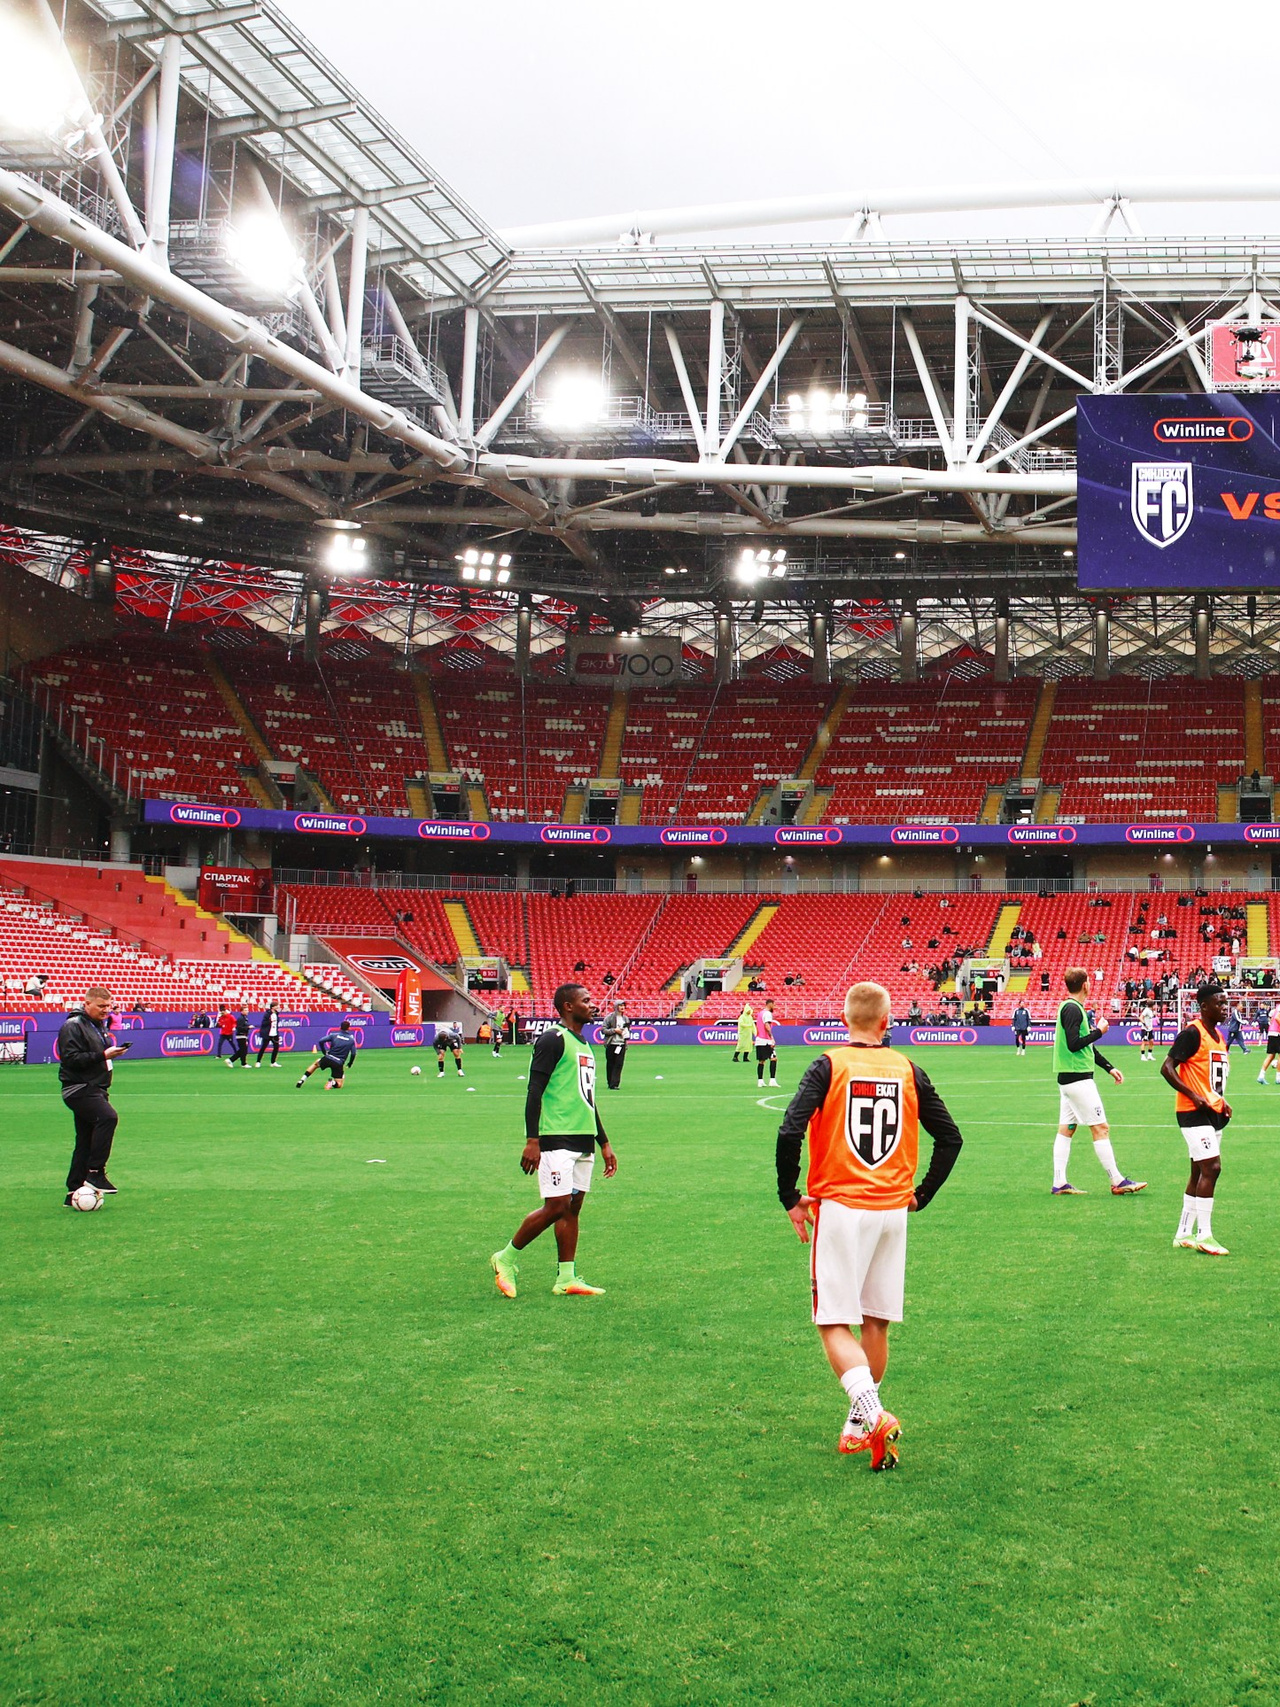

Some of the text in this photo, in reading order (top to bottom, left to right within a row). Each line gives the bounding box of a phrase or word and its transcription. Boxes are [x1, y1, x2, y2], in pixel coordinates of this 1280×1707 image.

[1162, 423, 1226, 438] Winline
[1138, 481, 1187, 540] FC
[178, 808, 221, 822] Winline
[302, 817, 347, 831] Winline
[425, 825, 471, 837] Winline
[547, 829, 592, 840] Winline
[667, 831, 709, 842] Winline
[781, 831, 824, 841] Winline
[897, 830, 940, 840] Winline
[1014, 829, 1057, 840] Winline
[1132, 829, 1175, 839] Winline
[203, 872, 250, 883] СПАРТАК
[408, 988, 420, 1016] MFL
[394, 1031, 416, 1042] Winline
[704, 1031, 738, 1041] Winlin
[916, 1031, 958, 1041] Winline
[167, 1036, 200, 1049] Winline
[852, 1083, 897, 1097] СИНДЕКАТ
[850, 1098, 898, 1157] FC
